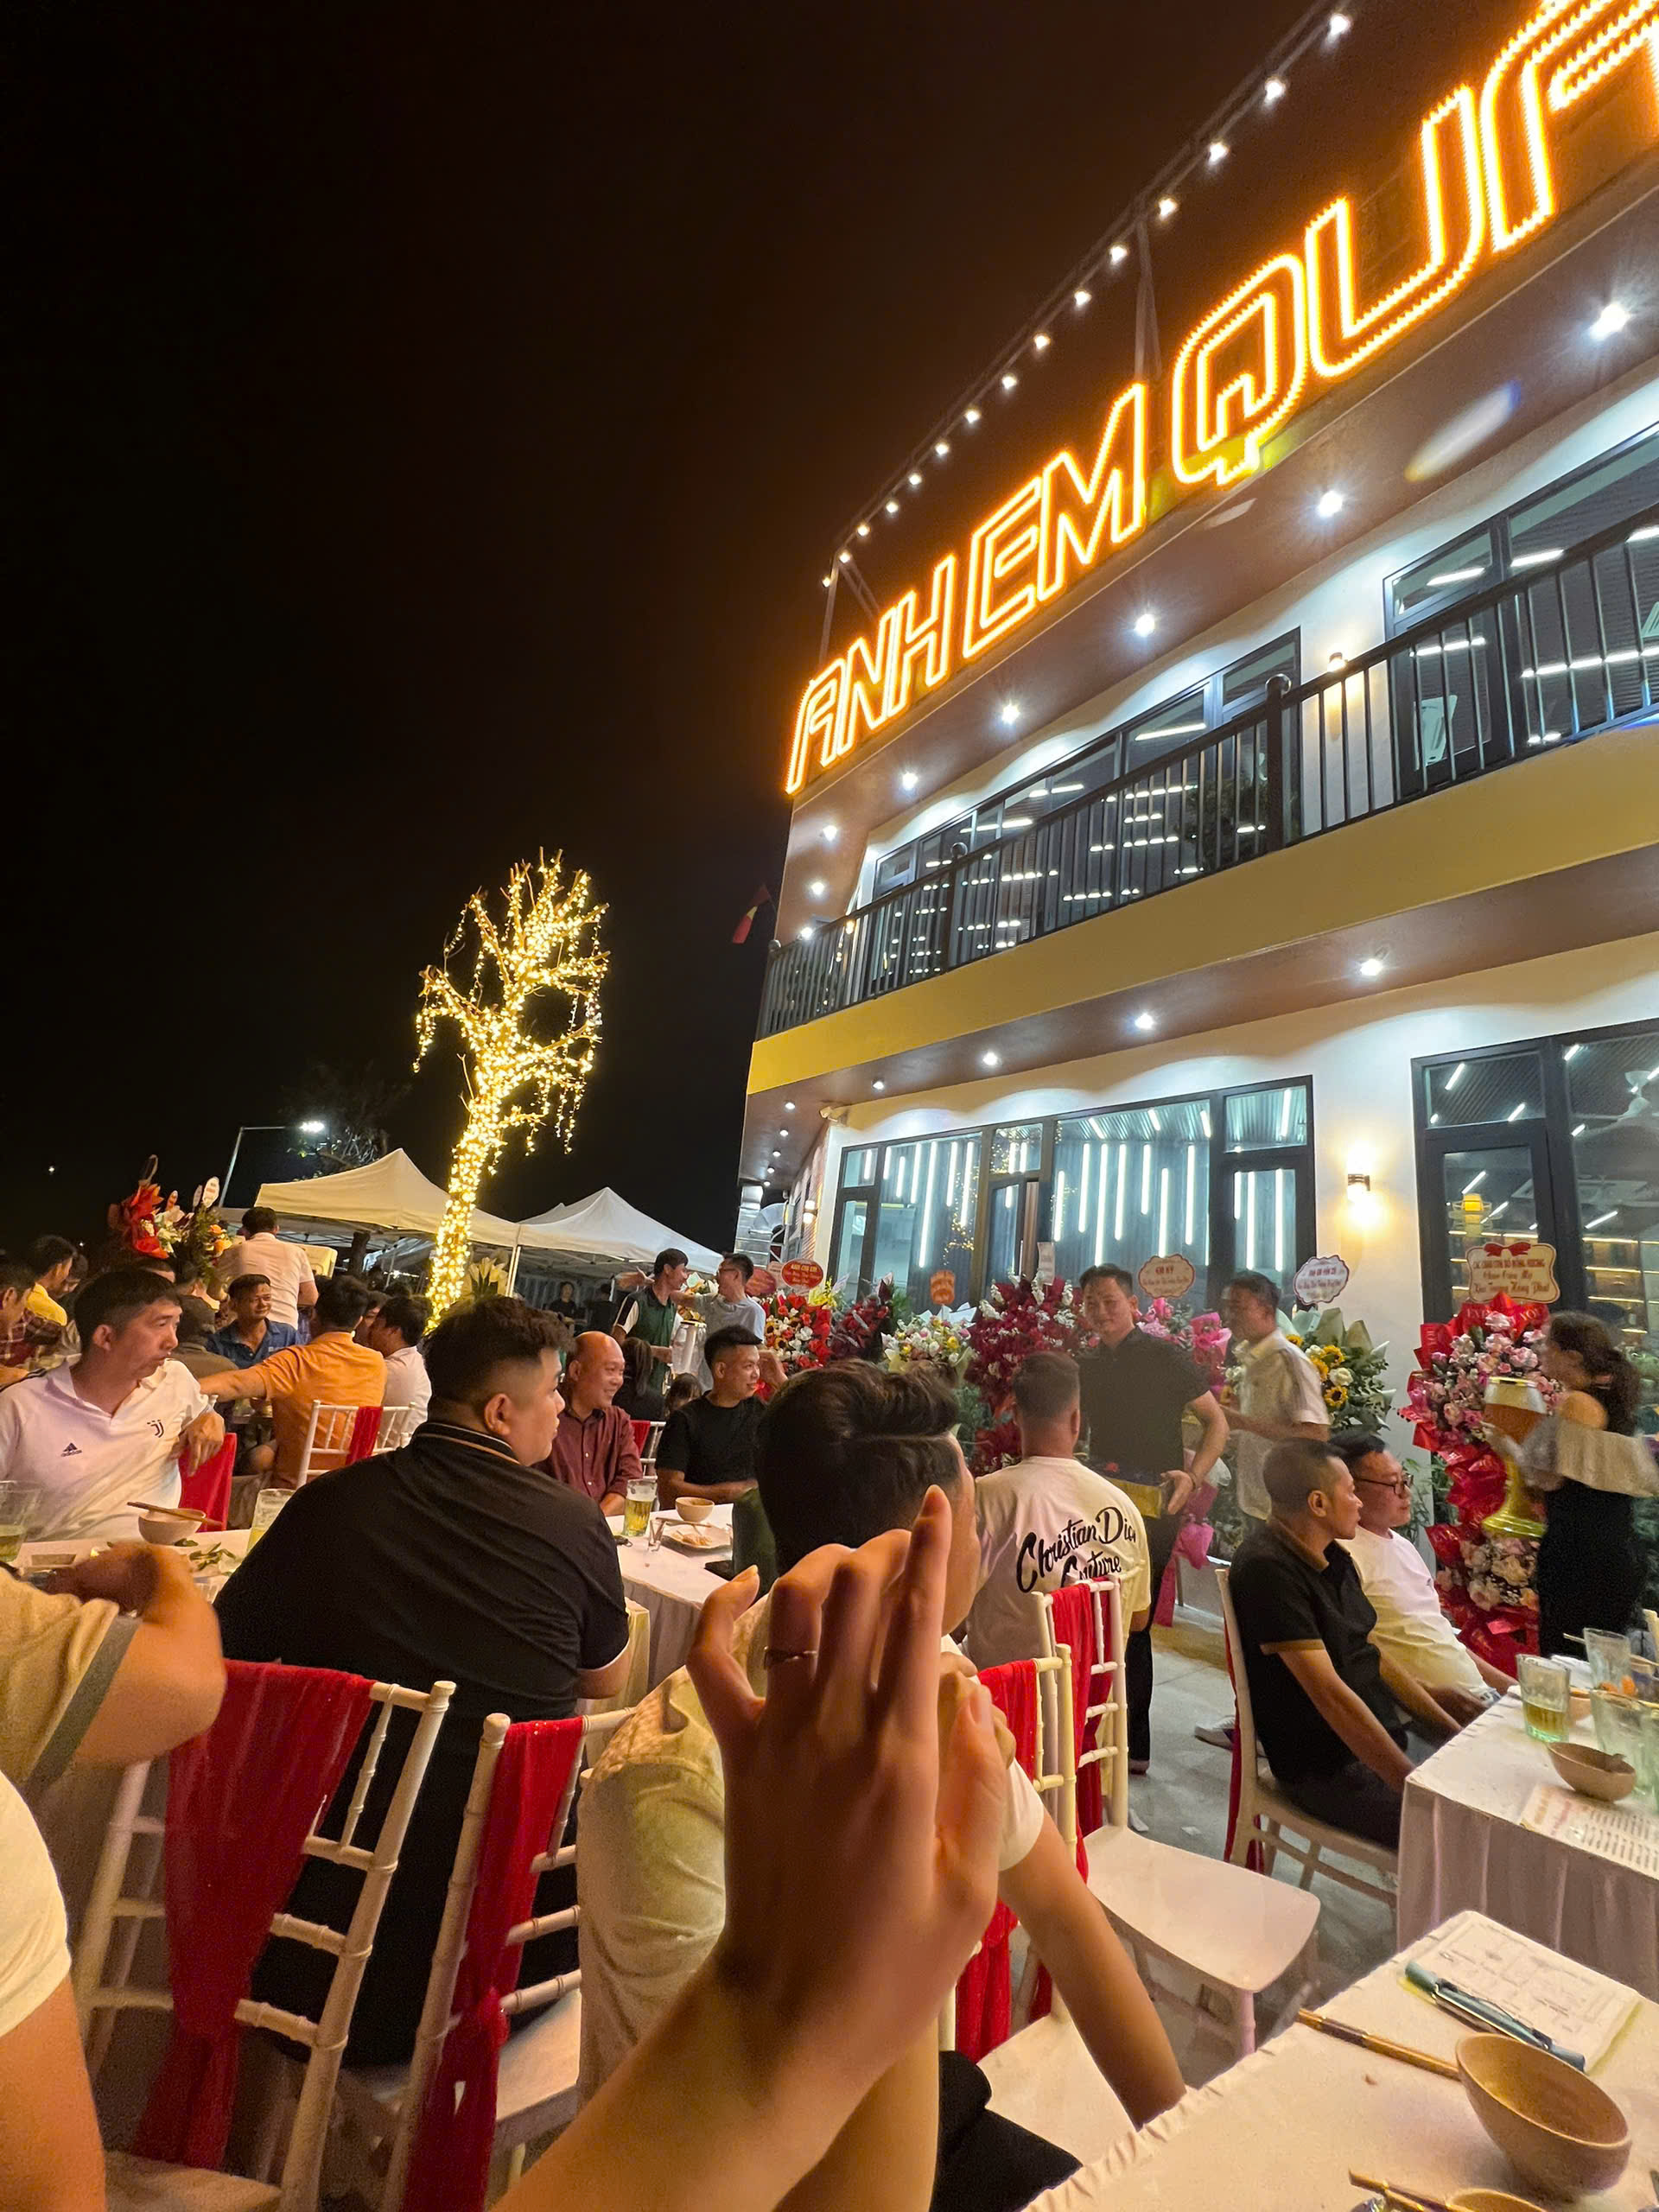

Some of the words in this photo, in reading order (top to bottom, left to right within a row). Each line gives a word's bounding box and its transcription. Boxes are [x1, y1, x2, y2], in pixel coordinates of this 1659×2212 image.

[785, 553, 957, 794] ANH
[963, 383, 1146, 658] EM
[1016, 1519, 1097, 1592] Christian
